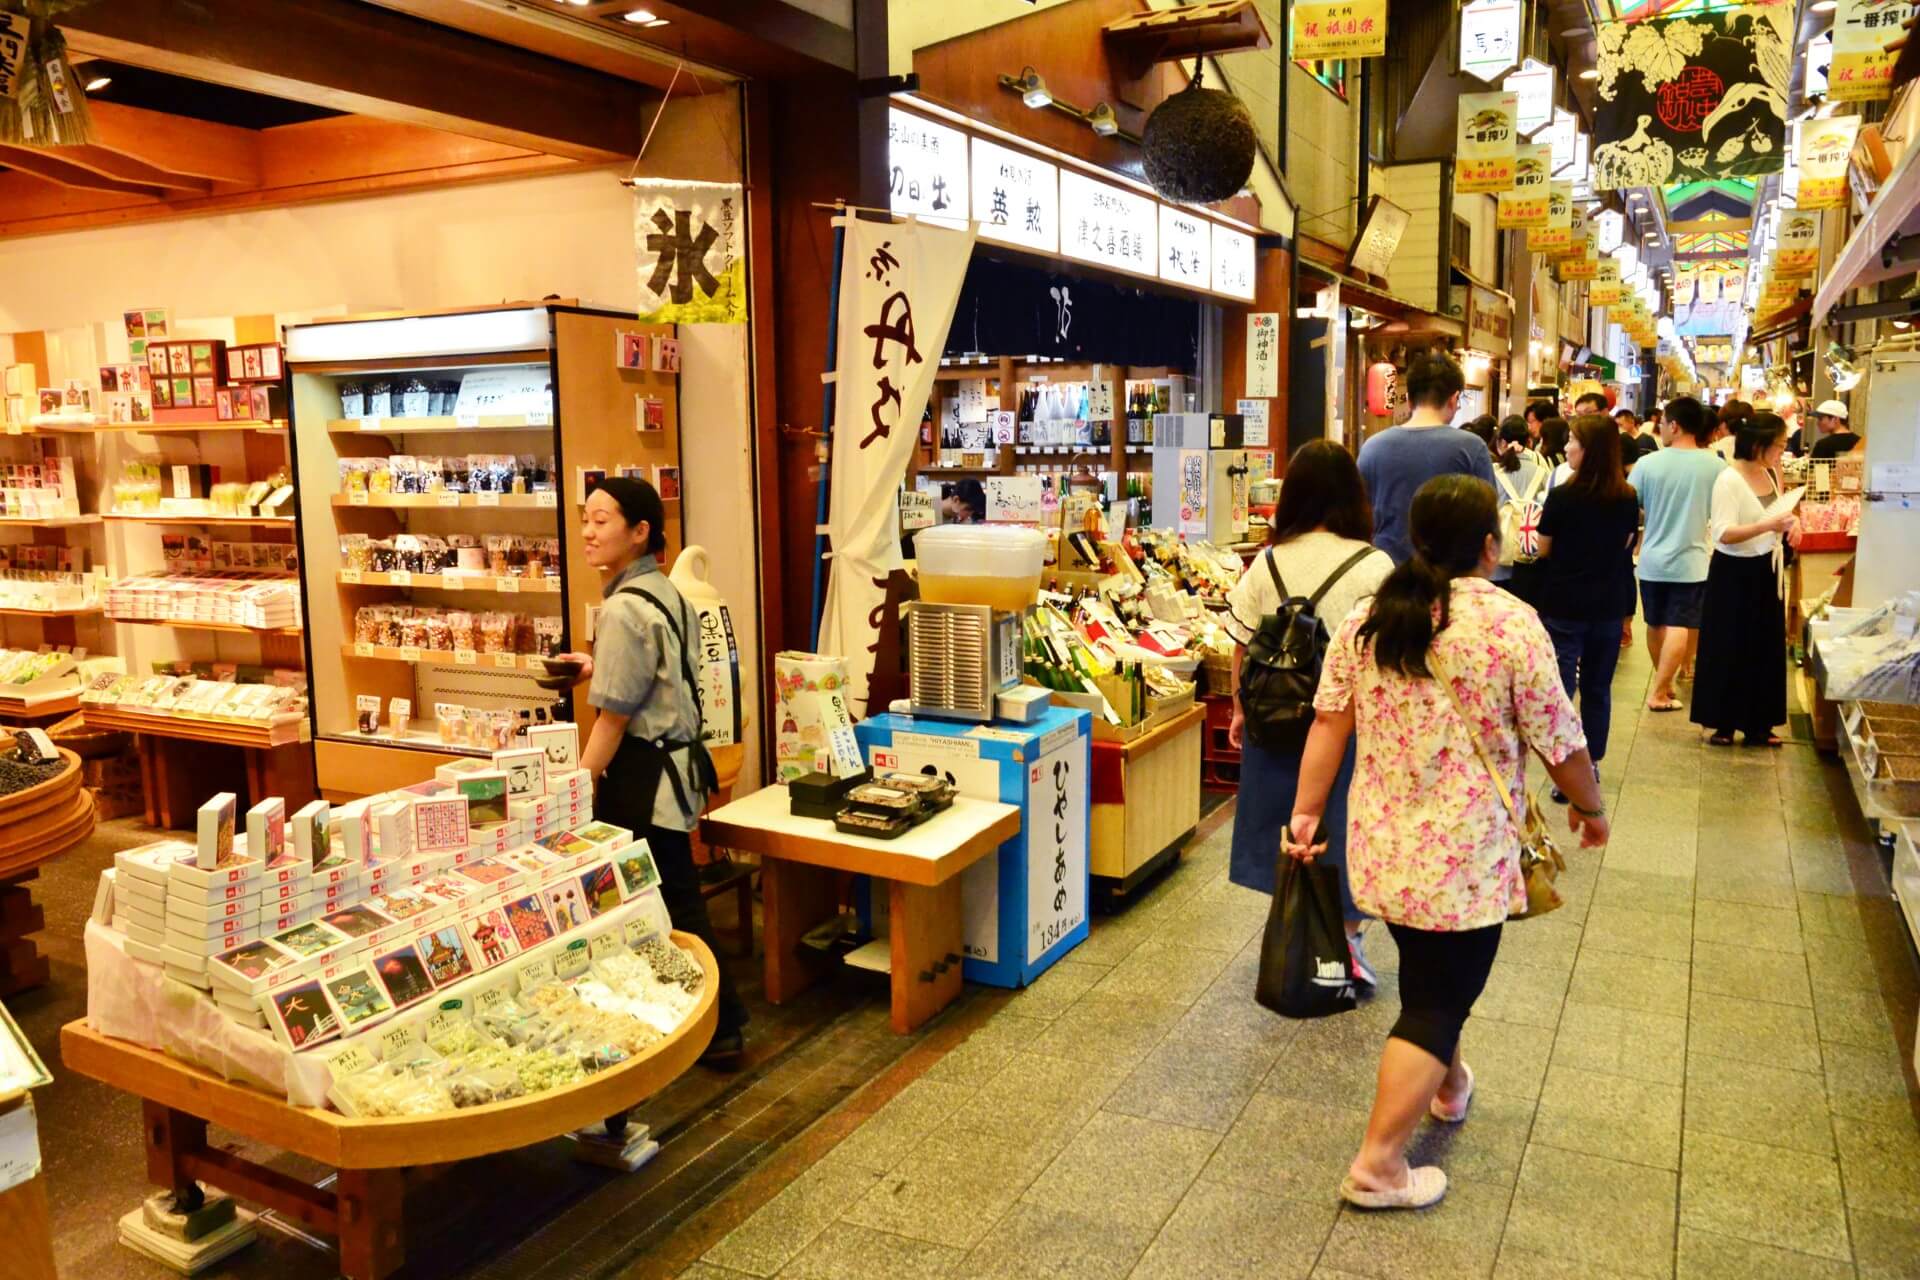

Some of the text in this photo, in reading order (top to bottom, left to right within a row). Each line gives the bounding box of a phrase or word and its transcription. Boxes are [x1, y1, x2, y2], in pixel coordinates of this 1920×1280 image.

[1465, 129, 1509, 142] 一番搾り
[646, 207, 721, 305] 氷
[720, 197, 738, 321] 黒豆ソフトクリーム入り
[700, 610, 726, 663] 黒豆
[1053, 759, 1070, 911] ひやしあめ
